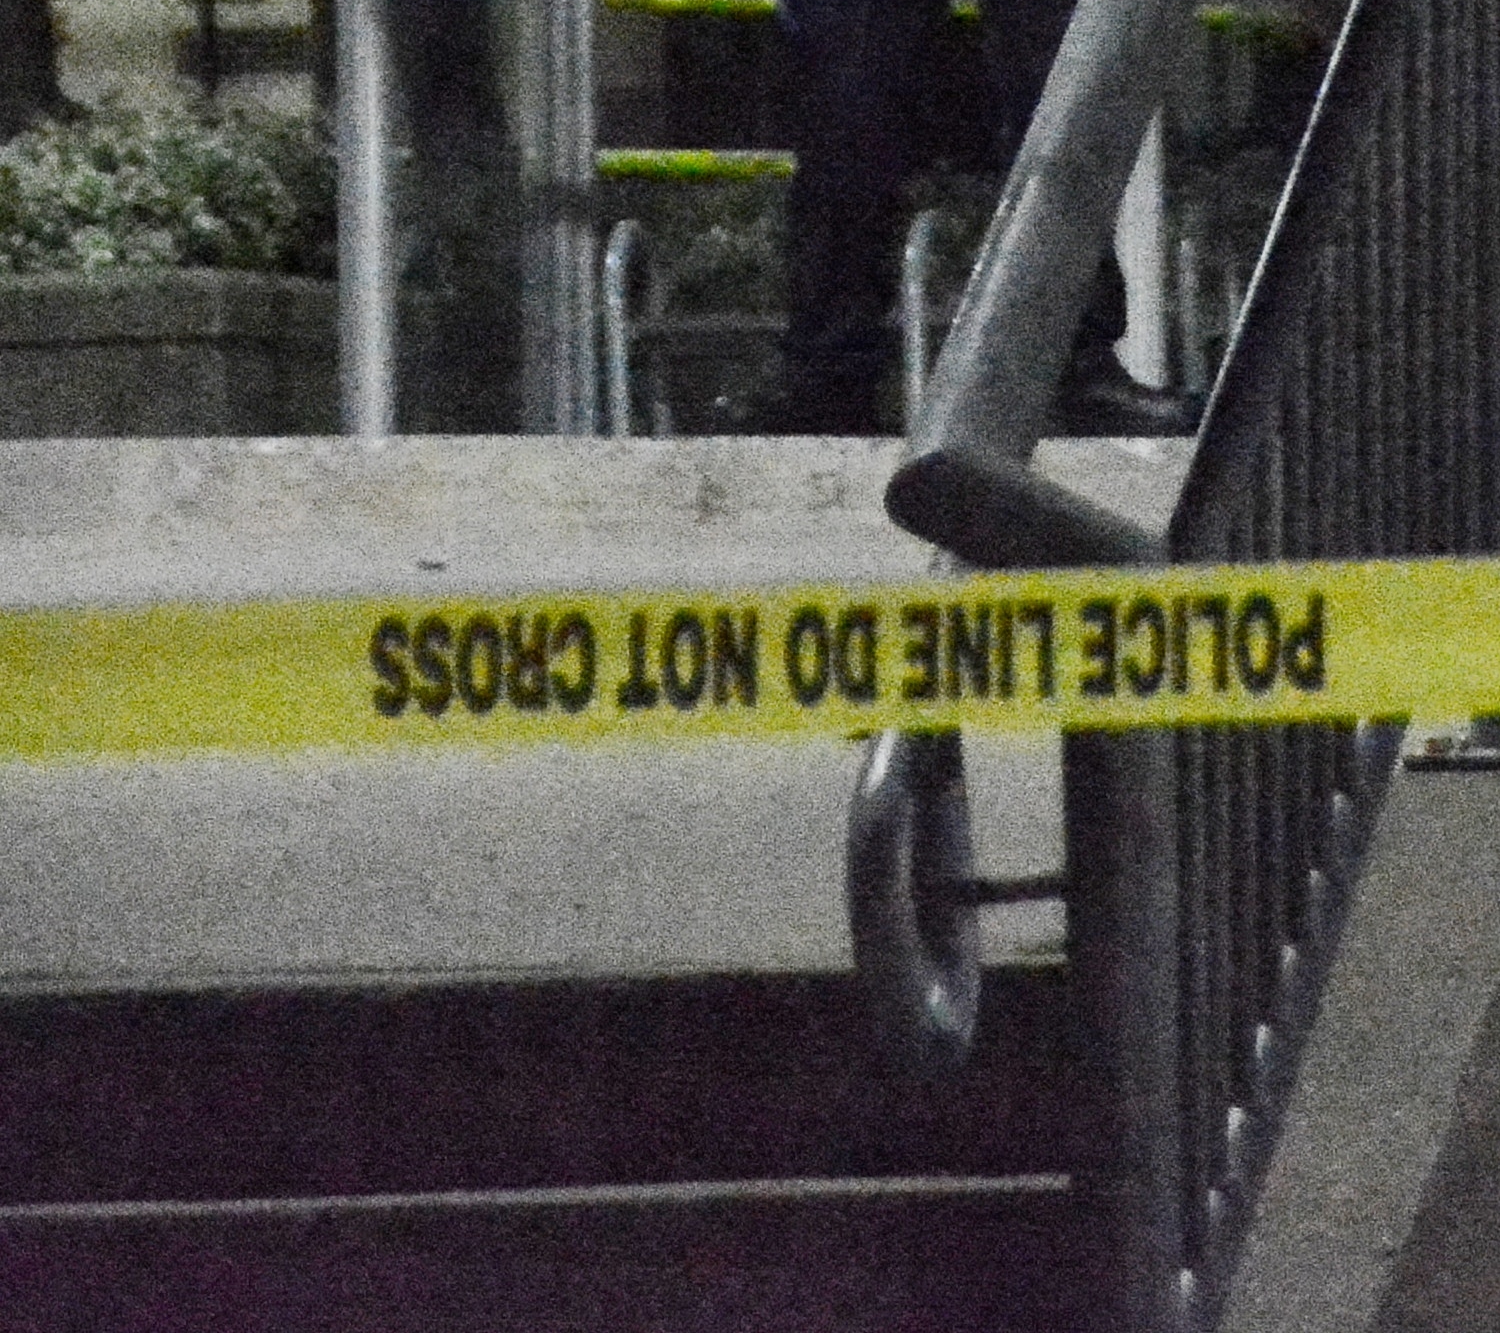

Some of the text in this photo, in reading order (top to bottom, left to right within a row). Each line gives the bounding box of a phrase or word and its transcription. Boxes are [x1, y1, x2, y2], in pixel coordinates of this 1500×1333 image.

[370, 590, 1324, 718] POLICE LINE DO NOT CROSS
